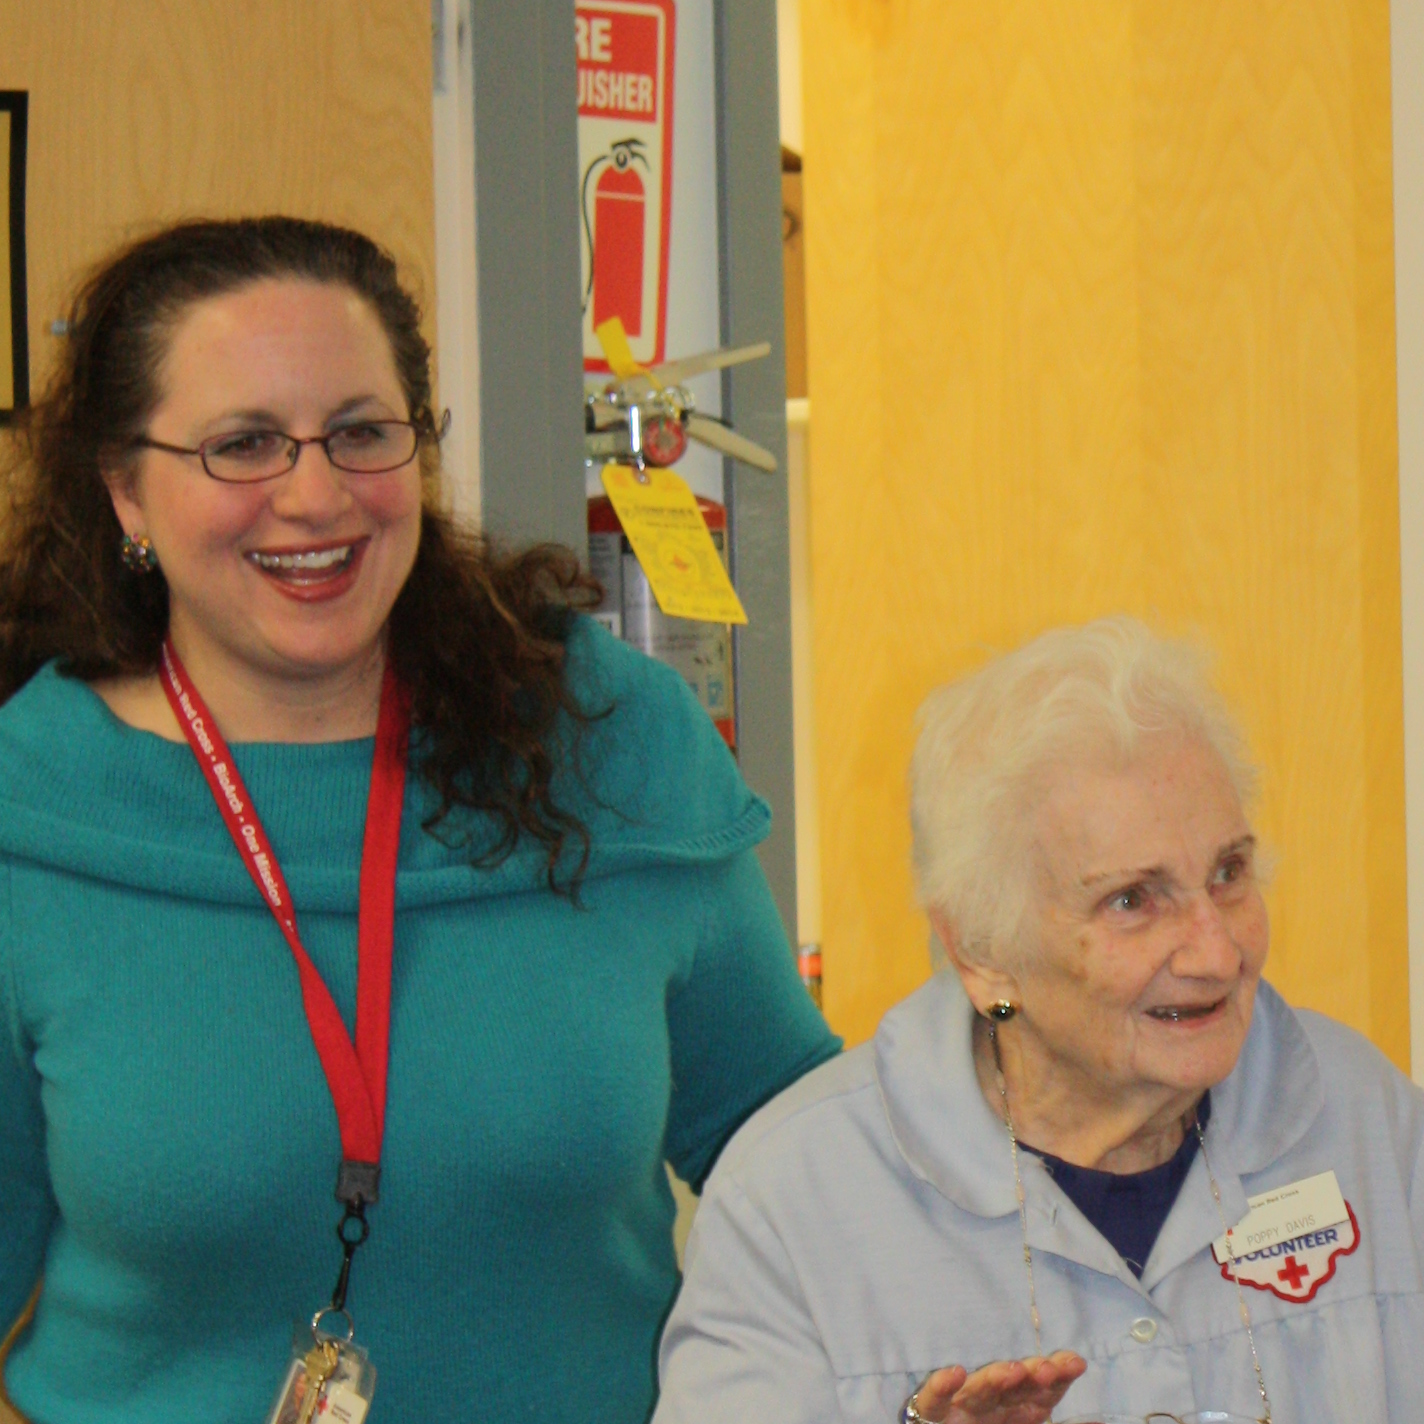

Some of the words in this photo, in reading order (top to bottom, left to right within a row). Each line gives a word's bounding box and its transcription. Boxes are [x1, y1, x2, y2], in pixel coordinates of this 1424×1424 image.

[191, 717, 215, 755] Cross
[242, 824, 260, 854] One
[254, 852, 282, 907] Mission
[1246, 1226, 1279, 1247] POPPY
[1285, 1214, 1316, 1234] DAVIS
